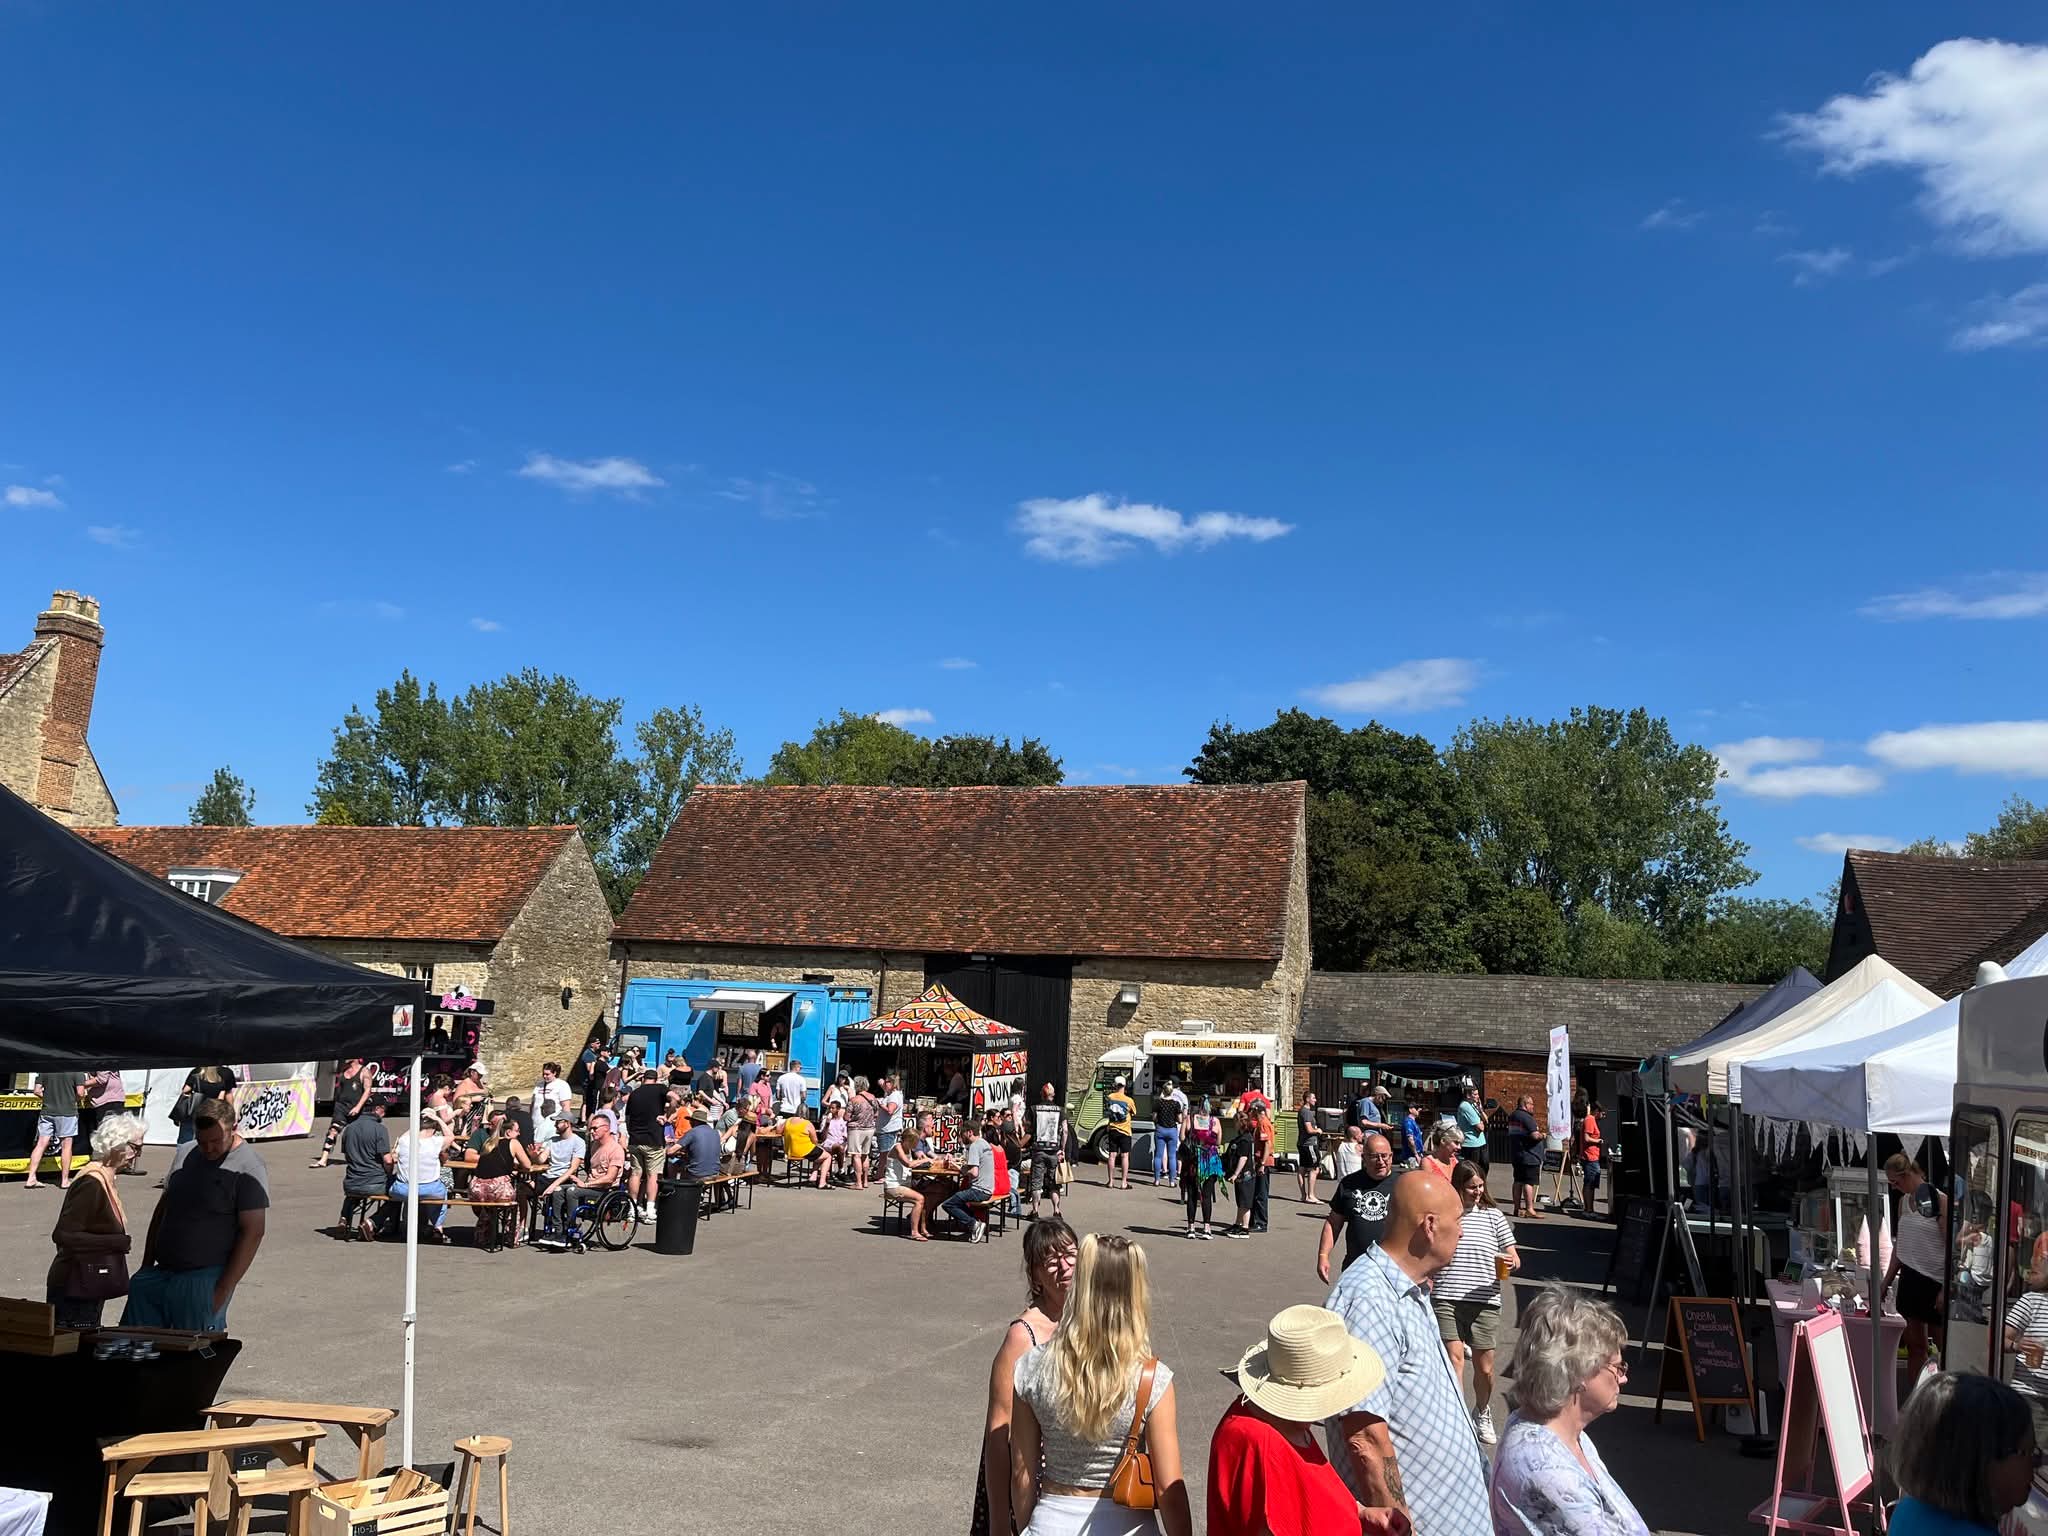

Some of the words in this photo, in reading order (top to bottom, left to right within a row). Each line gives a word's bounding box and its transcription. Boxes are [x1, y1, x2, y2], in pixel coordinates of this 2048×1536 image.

[873, 1032, 903, 1047] NOW
[906, 1033, 936, 1048] NOW
[1174, 1040, 1195, 1048] CHEESE
[1195, 1040, 1230, 1049] SANDWICHES
[1236, 1041, 1257, 1049] COFFEE
[717, 1047, 765, 1069] PIZA
